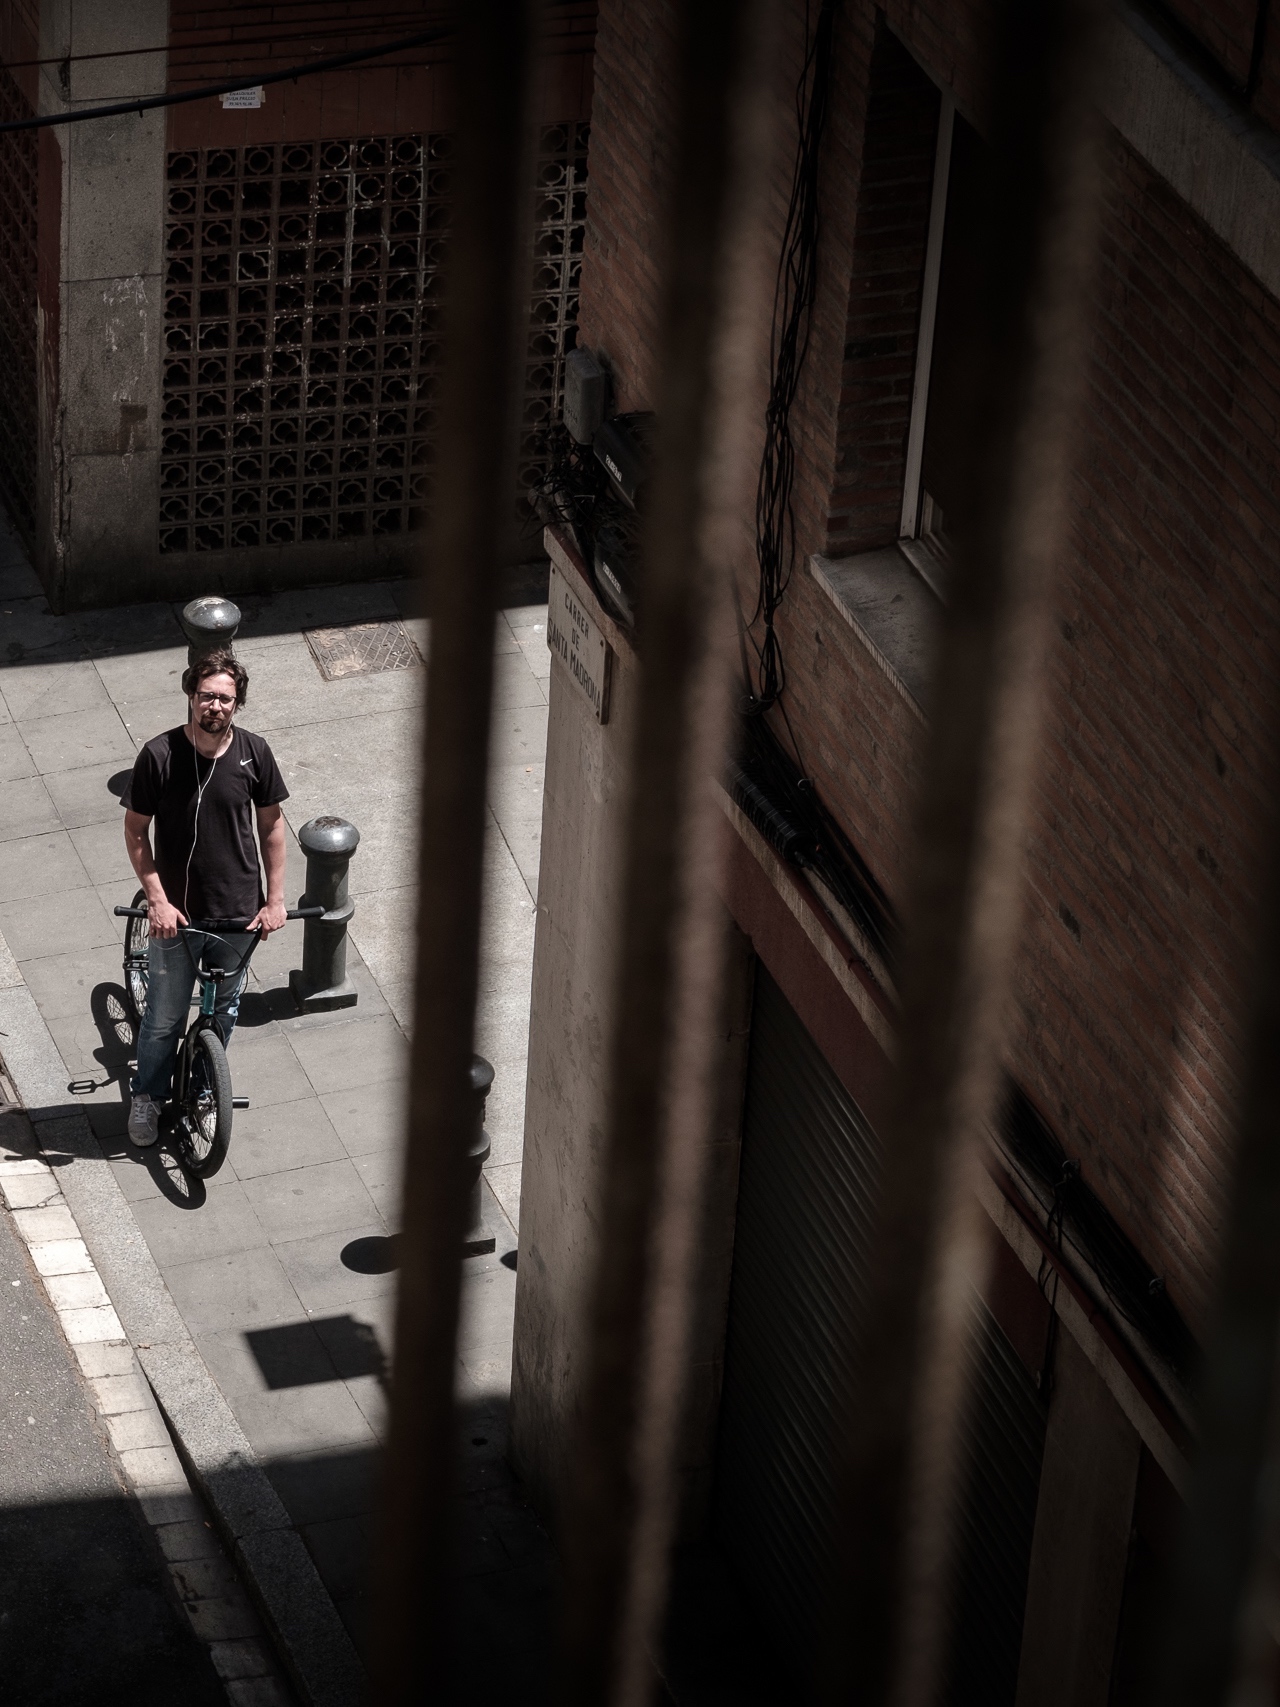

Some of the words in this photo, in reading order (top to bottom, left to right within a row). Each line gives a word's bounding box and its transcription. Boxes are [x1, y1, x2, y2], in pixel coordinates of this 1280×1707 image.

[565, 593, 589, 640] CARRER
[572, 628, 580, 651] DE
[548, 618, 568, 663] SANTA
[570, 650, 600, 709] MADRONA
